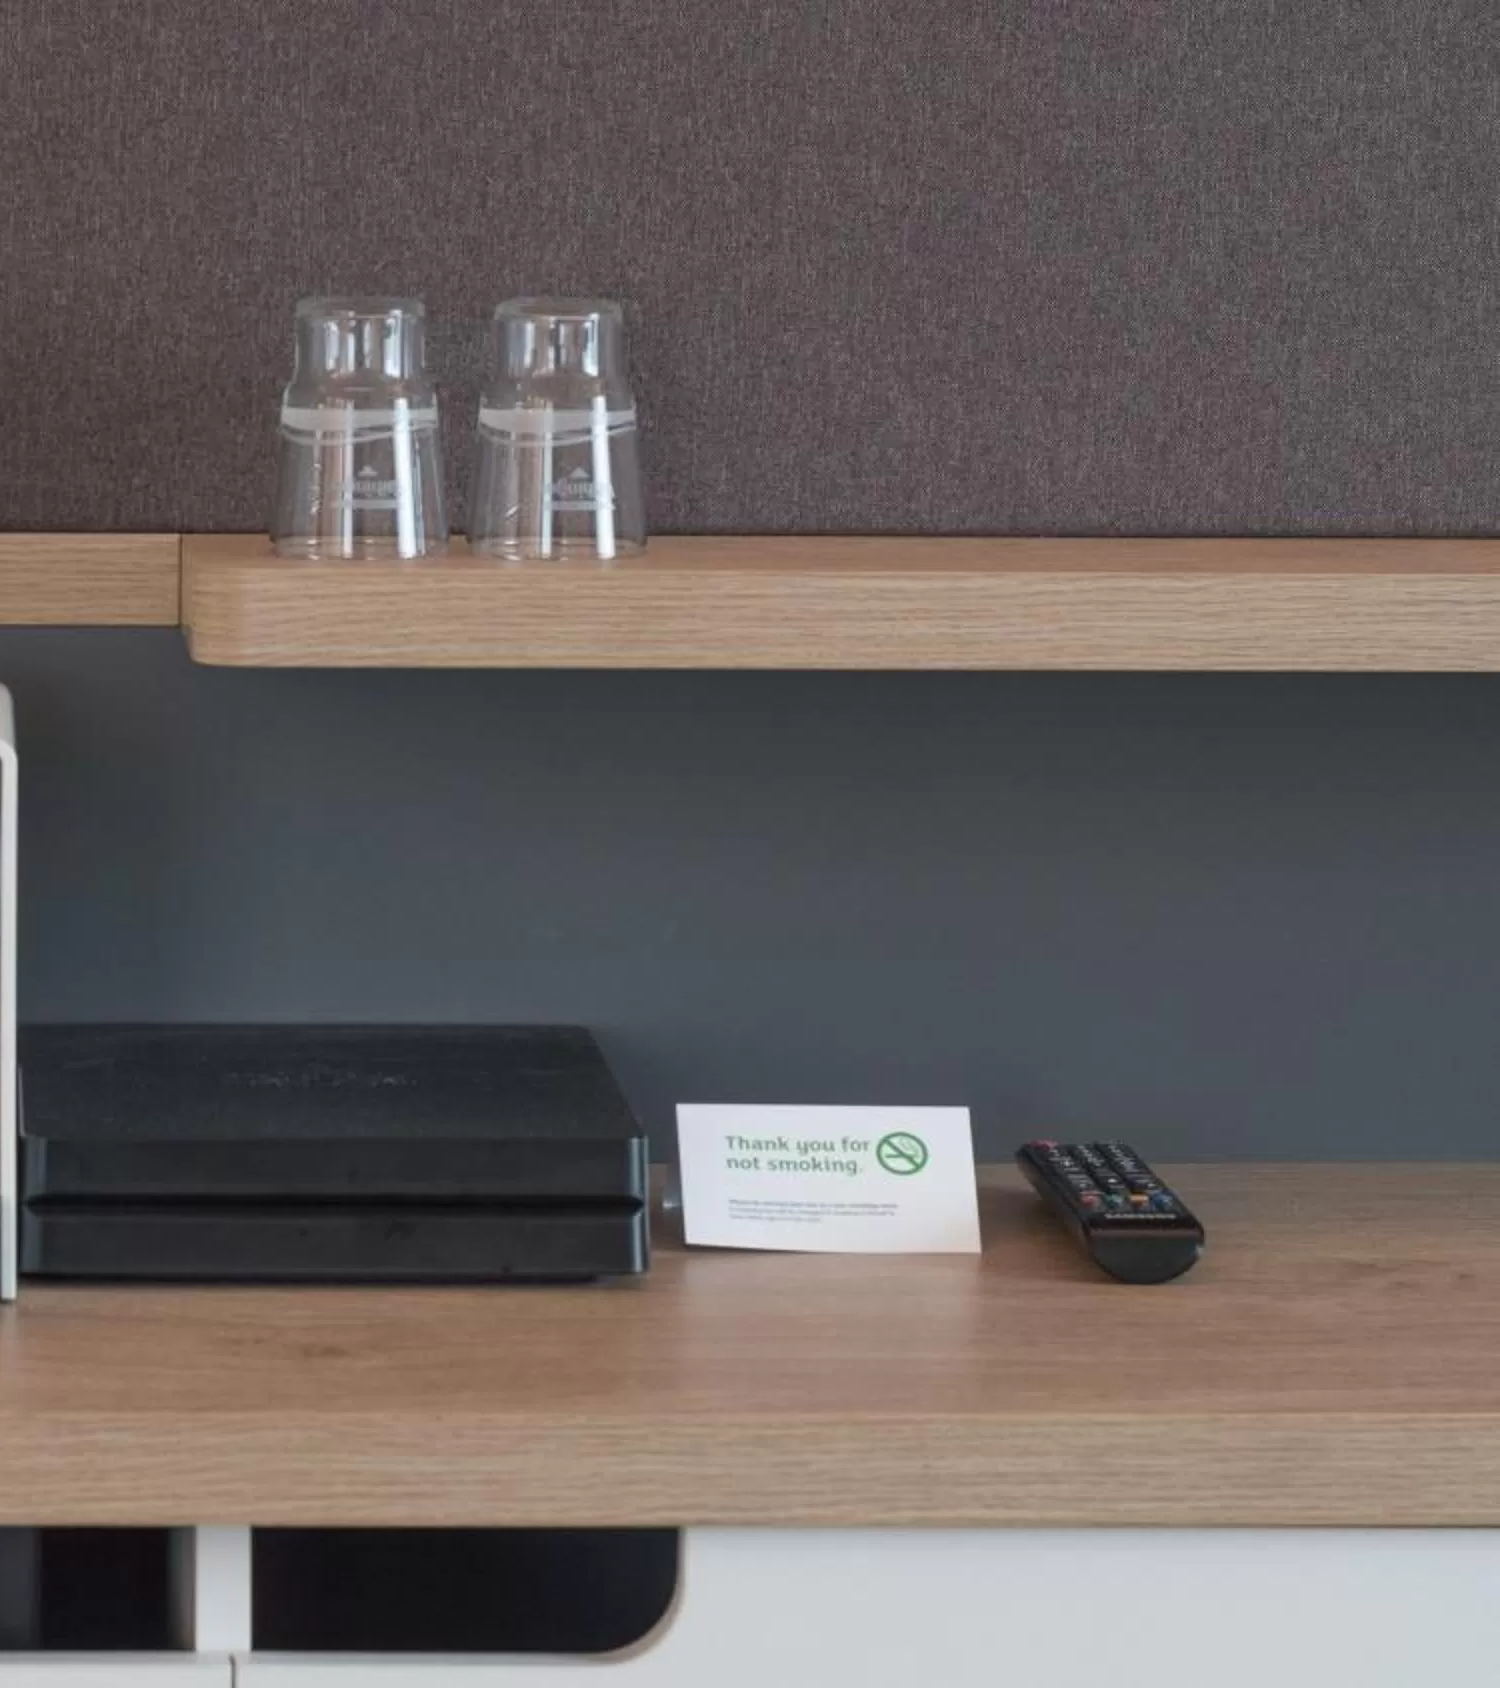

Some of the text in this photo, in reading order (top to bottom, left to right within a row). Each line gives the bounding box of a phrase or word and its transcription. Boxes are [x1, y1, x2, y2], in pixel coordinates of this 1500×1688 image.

[725, 1135, 870, 1155] Thank you for
[726, 1156, 863, 1176] not smoking.
